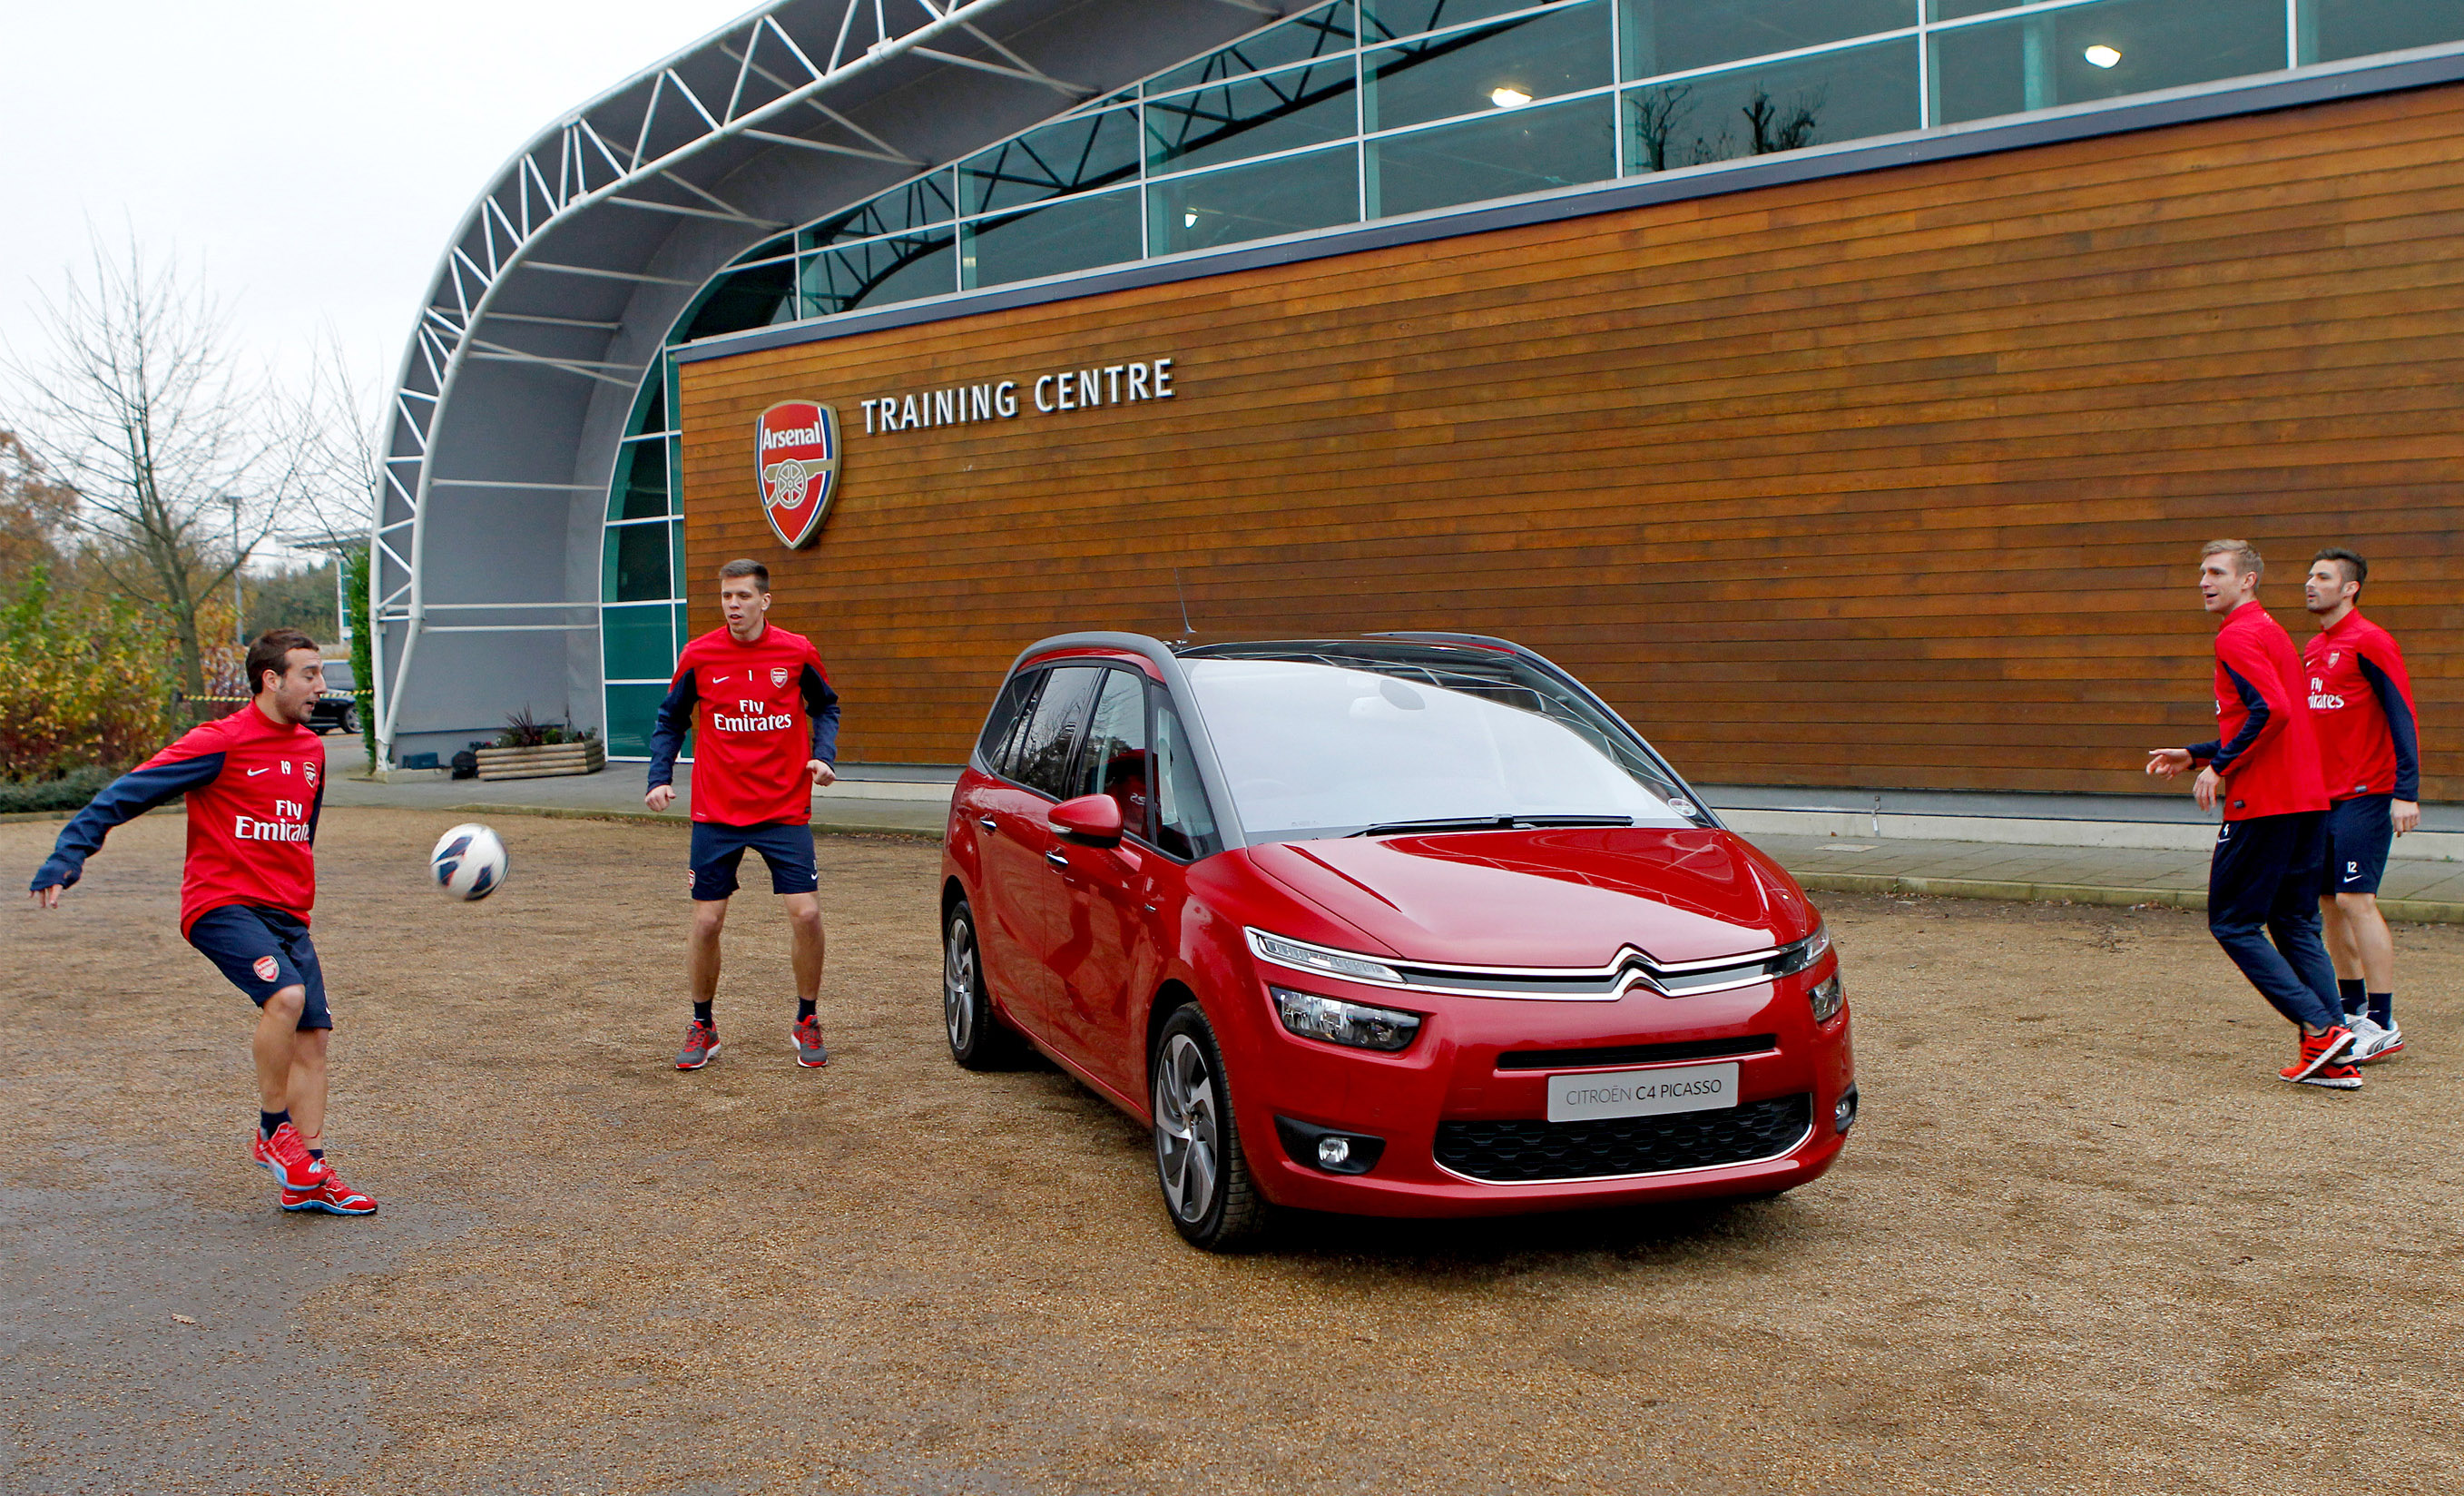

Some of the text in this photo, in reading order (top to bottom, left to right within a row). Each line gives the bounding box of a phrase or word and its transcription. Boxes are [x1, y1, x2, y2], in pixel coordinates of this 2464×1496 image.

[860, 357, 1175, 435] TRAINING CENTRE
[762, 421, 821, 450] Arsenal
[748, 670, 752, 681] 1
[2311, 677, 2323, 692] Fly
[739, 699, 764, 714] Fly
[713, 713, 792, 732] Emirates
[280, 761, 290, 774] 19
[276, 800, 302, 820] Fly
[2347, 861, 2358, 873] 12
[1566, 1079, 1722, 1105] CITROËN C4 PICASSO
